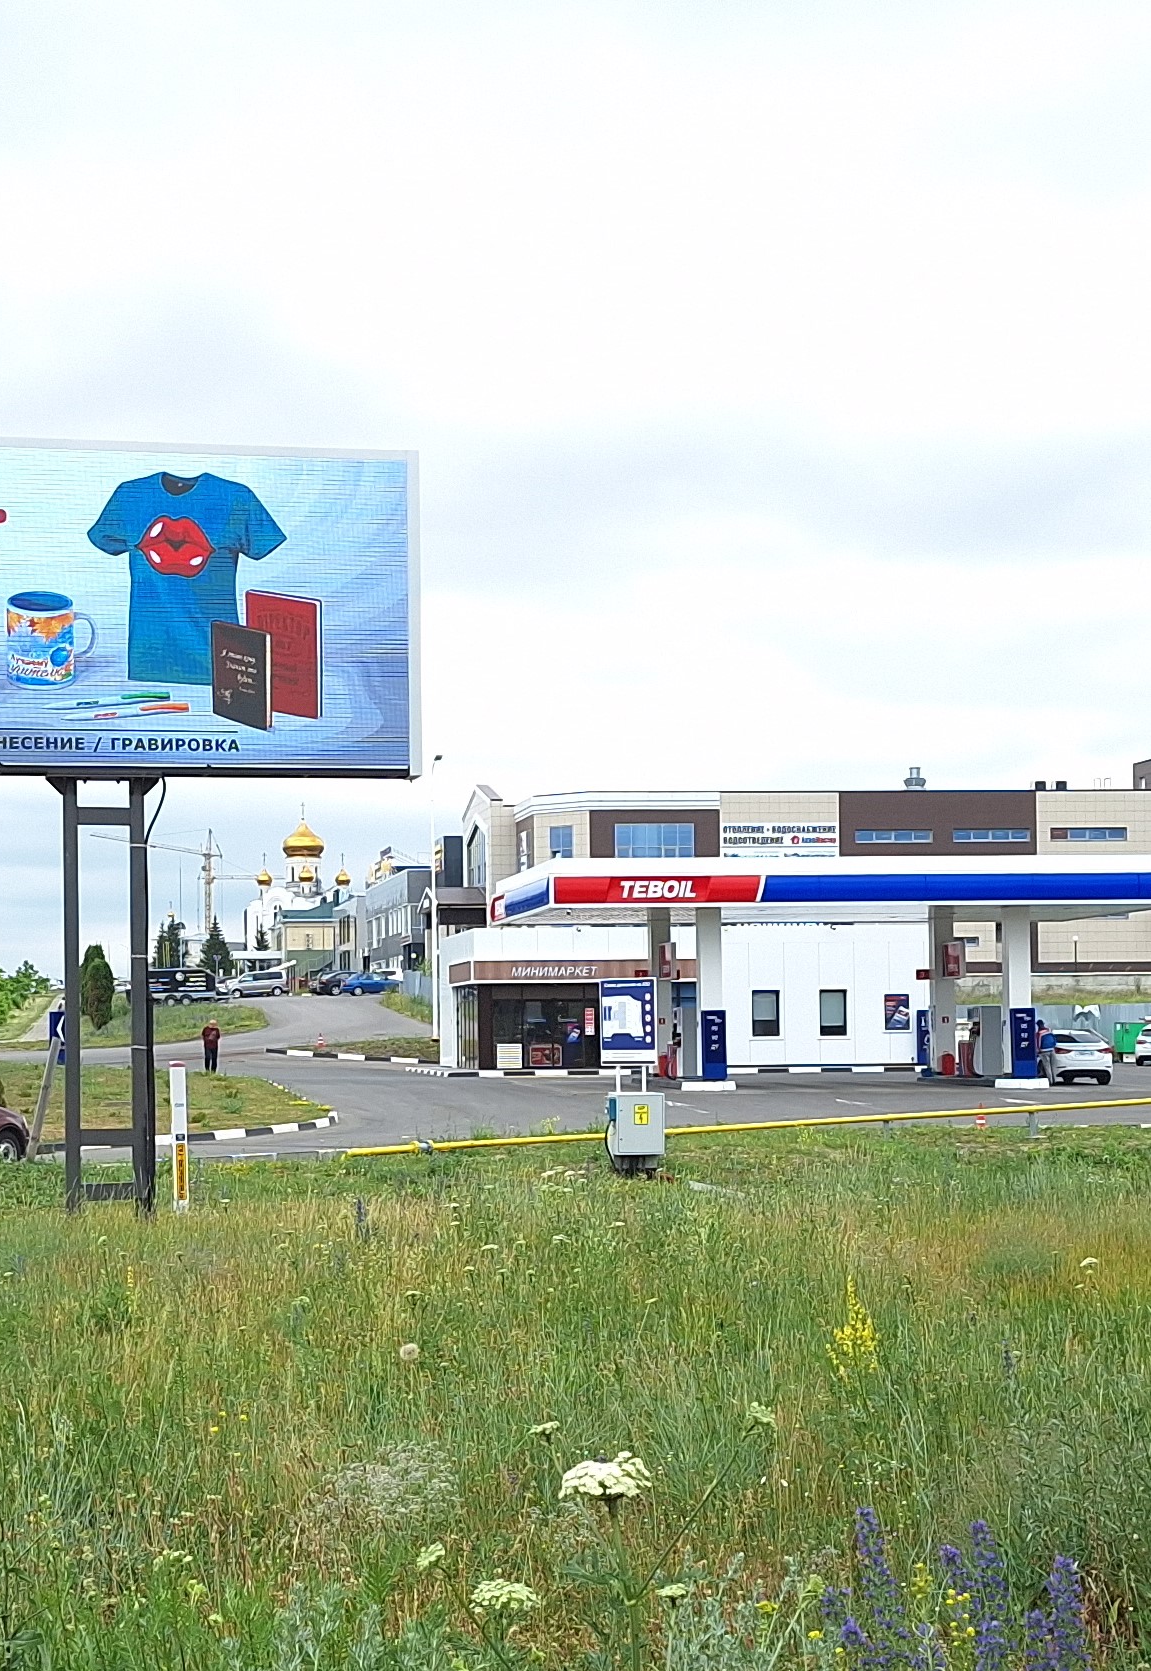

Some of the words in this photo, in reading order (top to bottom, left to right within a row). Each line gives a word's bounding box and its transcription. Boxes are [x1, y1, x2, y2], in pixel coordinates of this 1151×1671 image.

[111, 737, 240, 753] ГРАВИРОВКА
[620, 880, 697, 899] TEBOIL
[511, 966, 598, 977] МИНИМАРКЕТ
